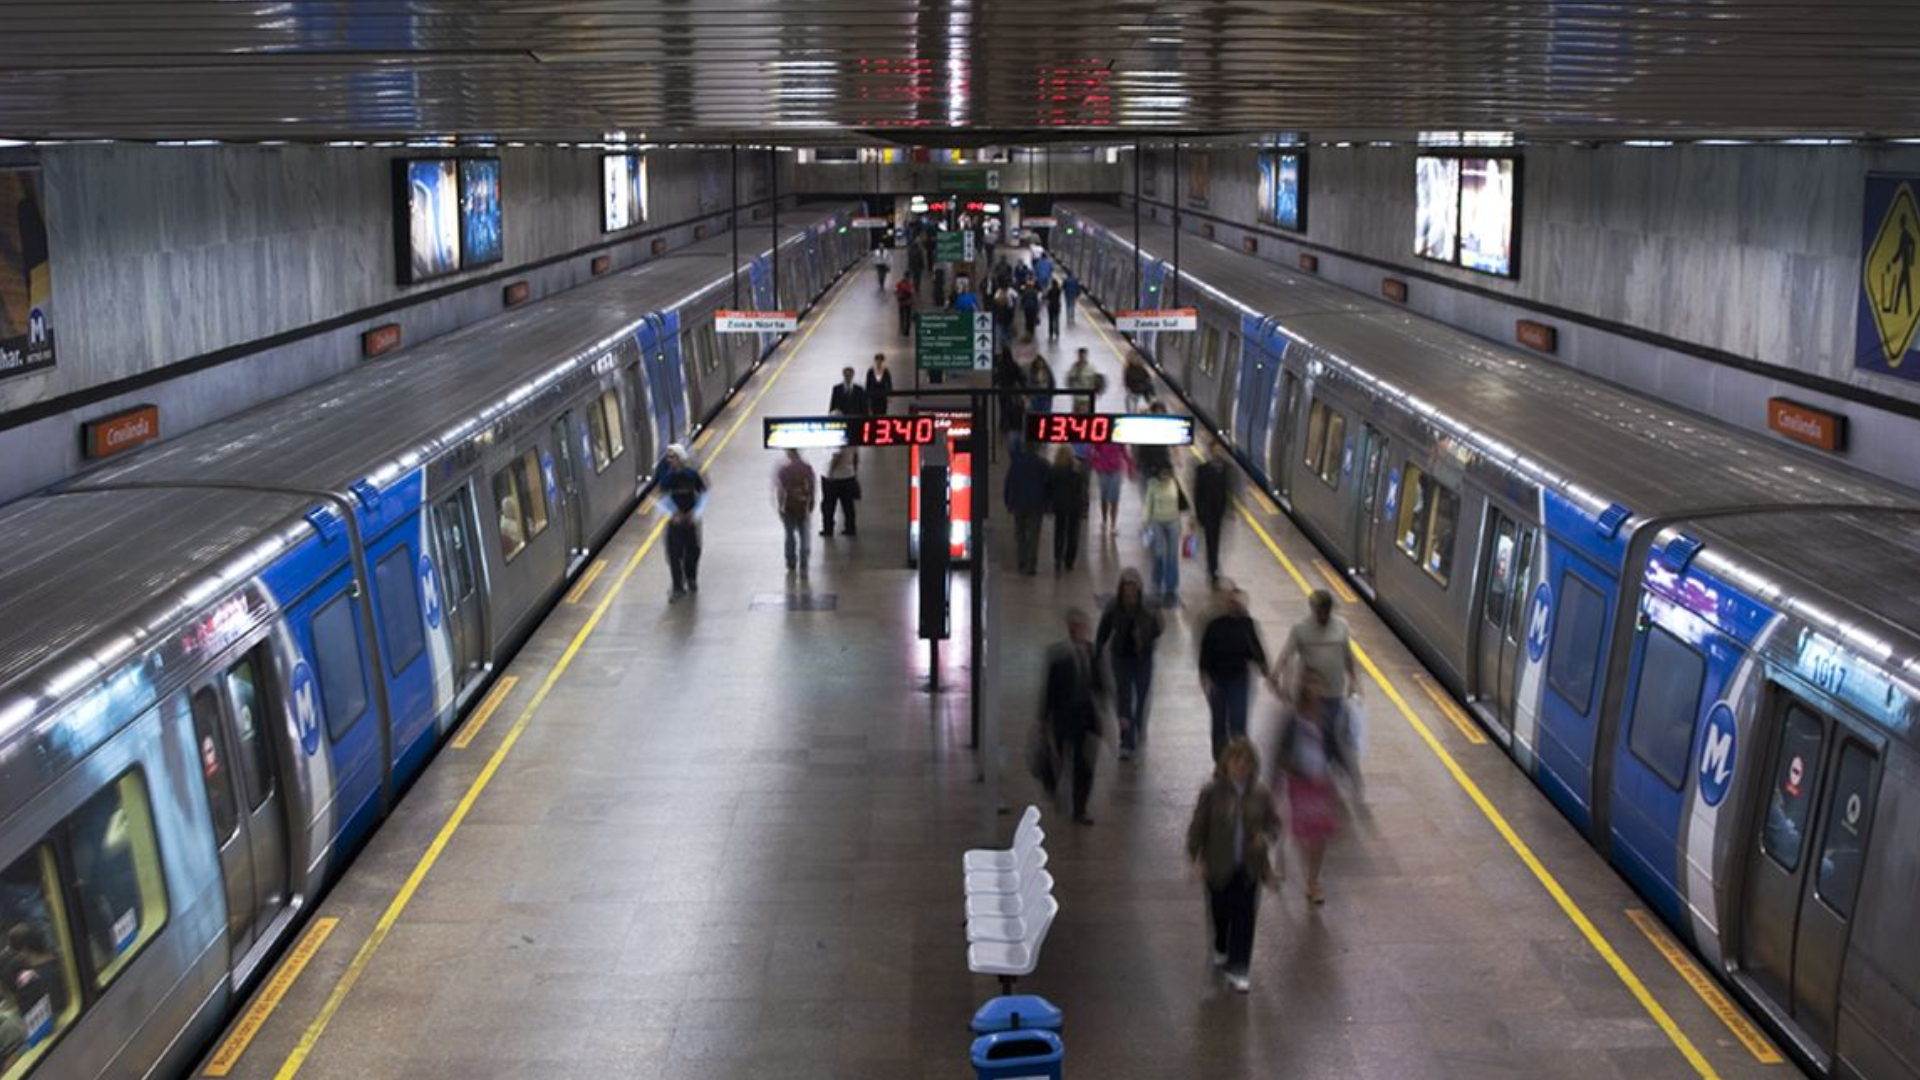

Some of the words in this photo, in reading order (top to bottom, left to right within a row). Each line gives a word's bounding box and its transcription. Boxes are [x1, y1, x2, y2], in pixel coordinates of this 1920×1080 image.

[727, 320, 752, 328] Zona
[755, 320, 785, 328] Norte
[1135, 319, 1159, 328] Zona
[1162, 319, 1178, 327] Sul
[1530, 598, 1549, 645] M
[1813, 655, 1847, 695] 1017
[295, 679, 316, 738] M
[1701, 722, 1732, 785] M
